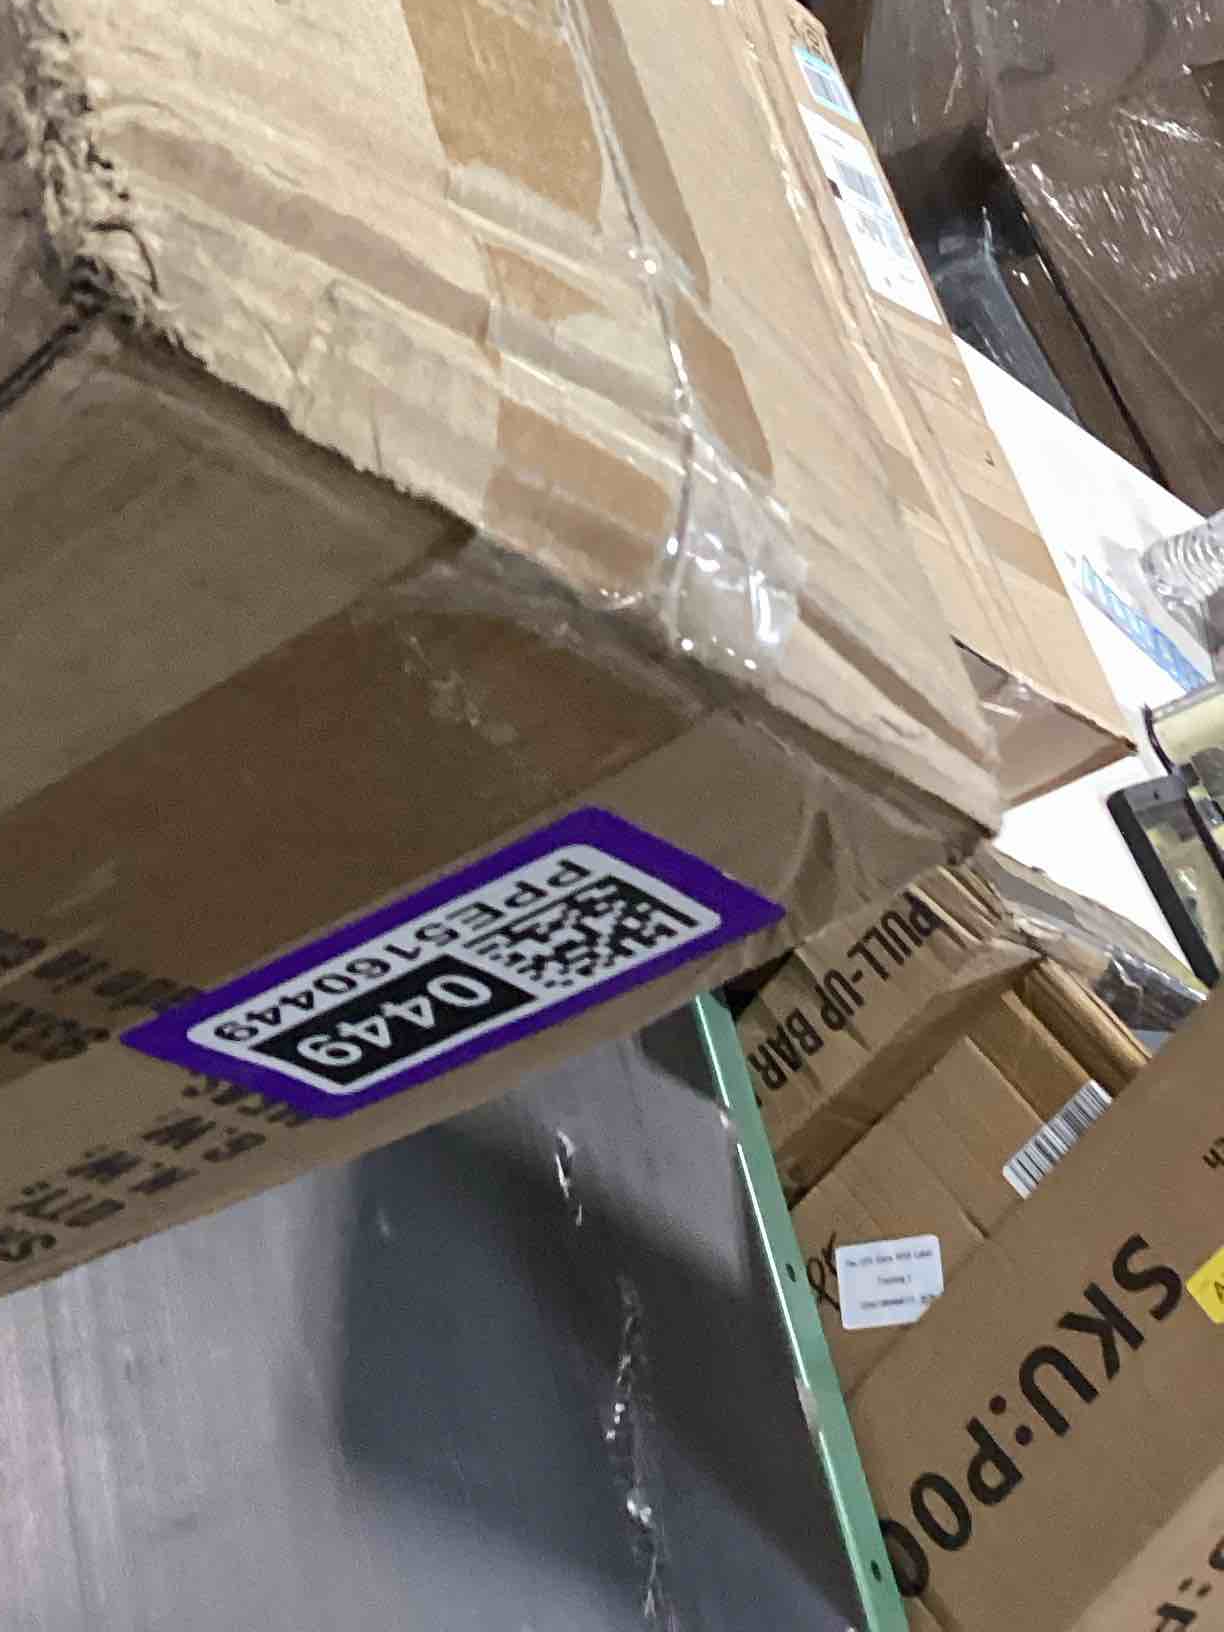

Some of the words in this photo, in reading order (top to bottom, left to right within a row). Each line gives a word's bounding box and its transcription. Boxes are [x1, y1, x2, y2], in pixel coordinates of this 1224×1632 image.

[219, 858, 584, 1044] PPE5160449
[822, 894, 941, 1034] PULL-UP
[296, 972, 492, 1068] 0449
[757, 1013, 823, 1090] BAR
